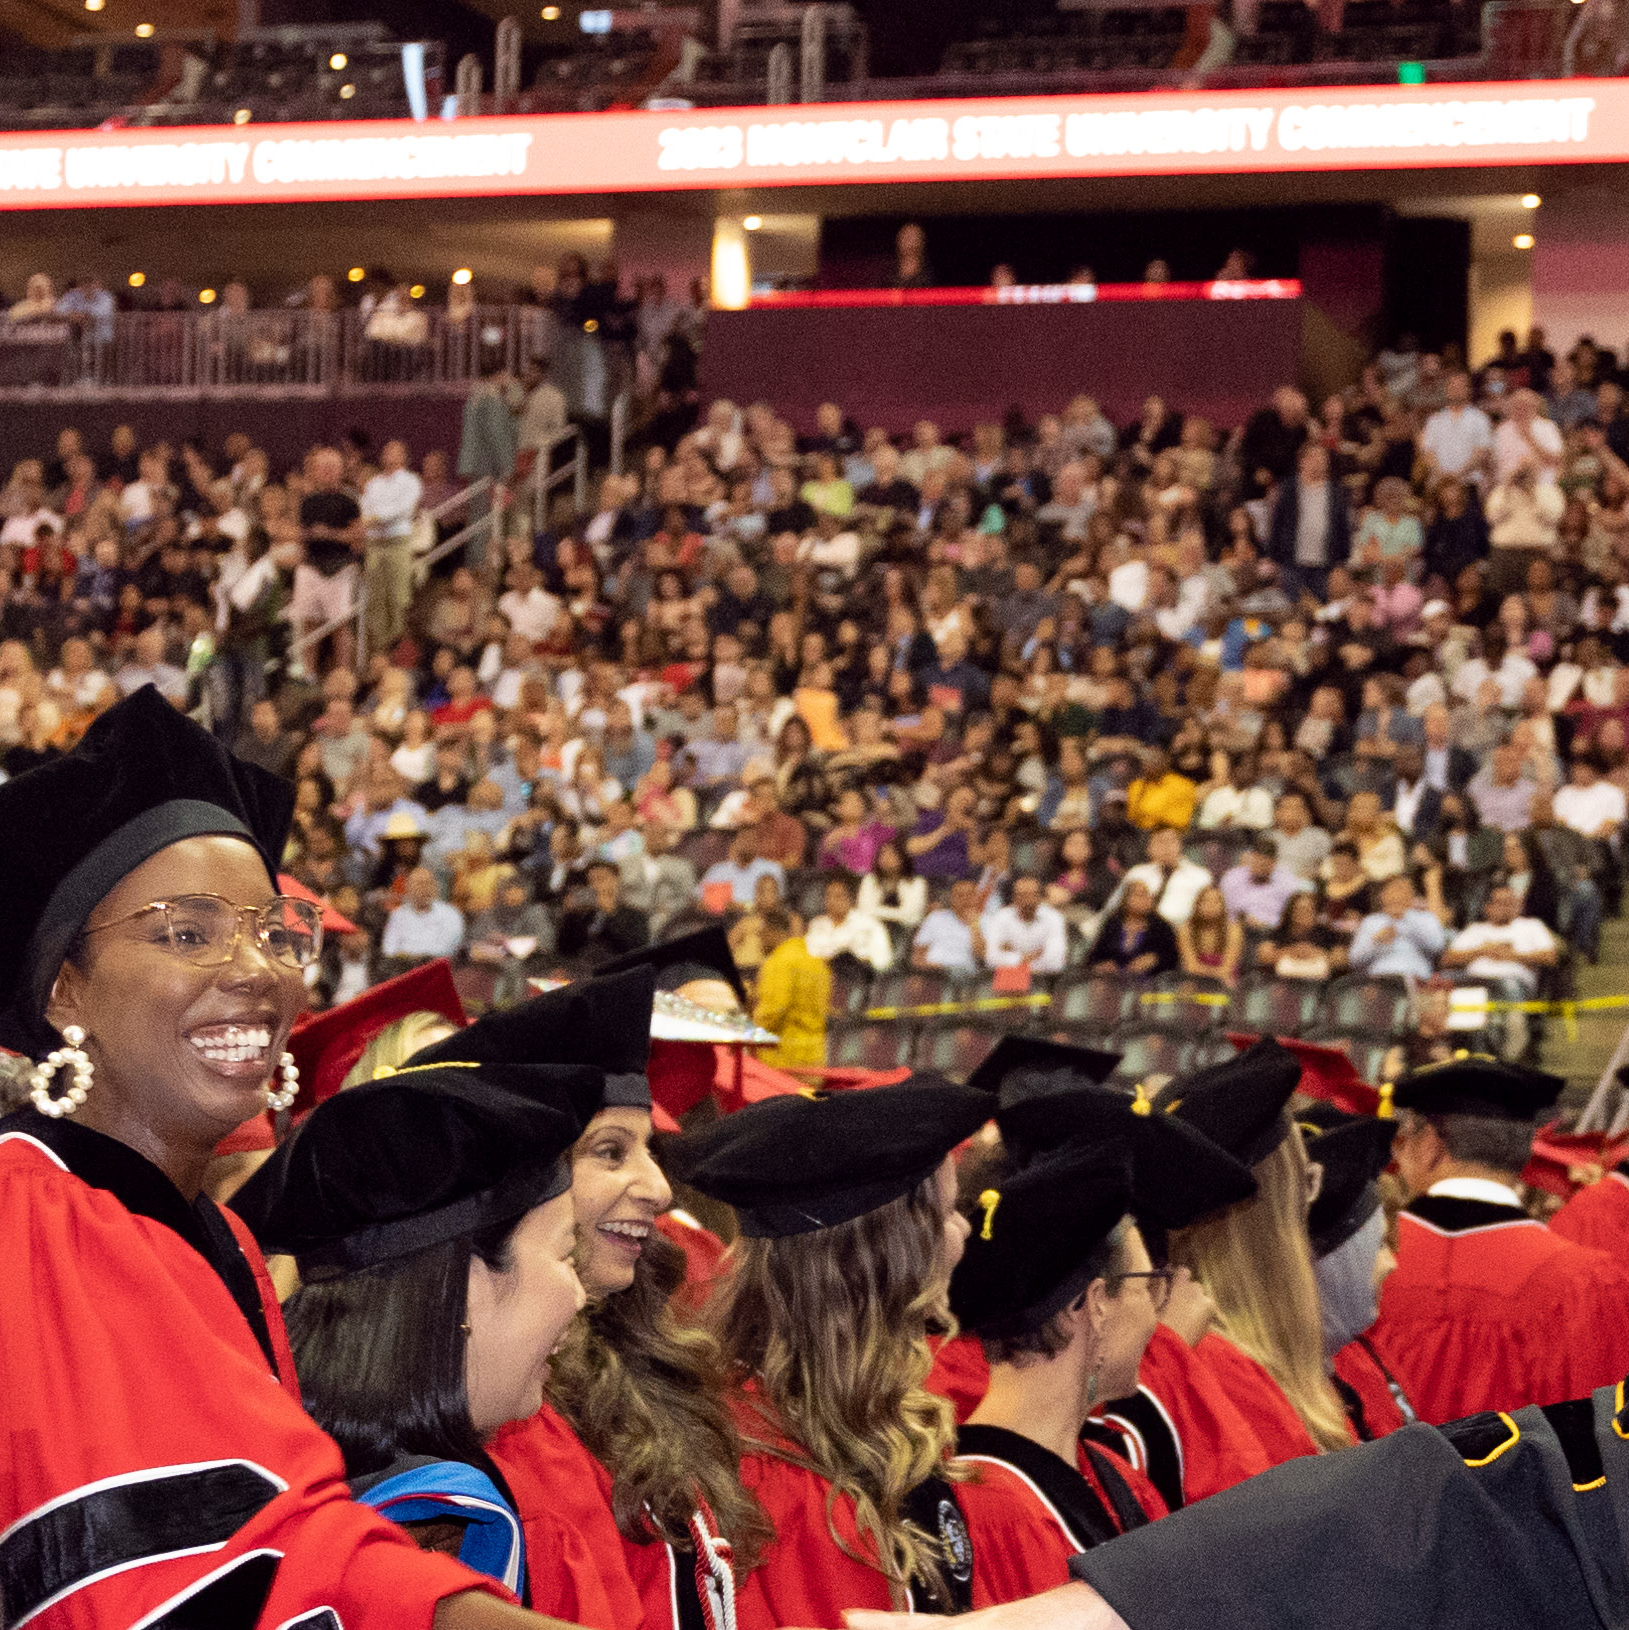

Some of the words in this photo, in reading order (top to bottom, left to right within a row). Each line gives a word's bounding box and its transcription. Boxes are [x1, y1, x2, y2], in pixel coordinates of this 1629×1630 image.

[65, 142, 249, 189] UNIVERSITY
[254, 133, 531, 183] COMMENCEMENT
[658, 126, 742, 170] 2023
[746, 118, 947, 166] MONTCLAIR
[952, 114, 1059, 160] STATE
[1065, 108, 1273, 157] UNIVERSITY
[1278, 98, 1594, 151] COMMENCEMENT
